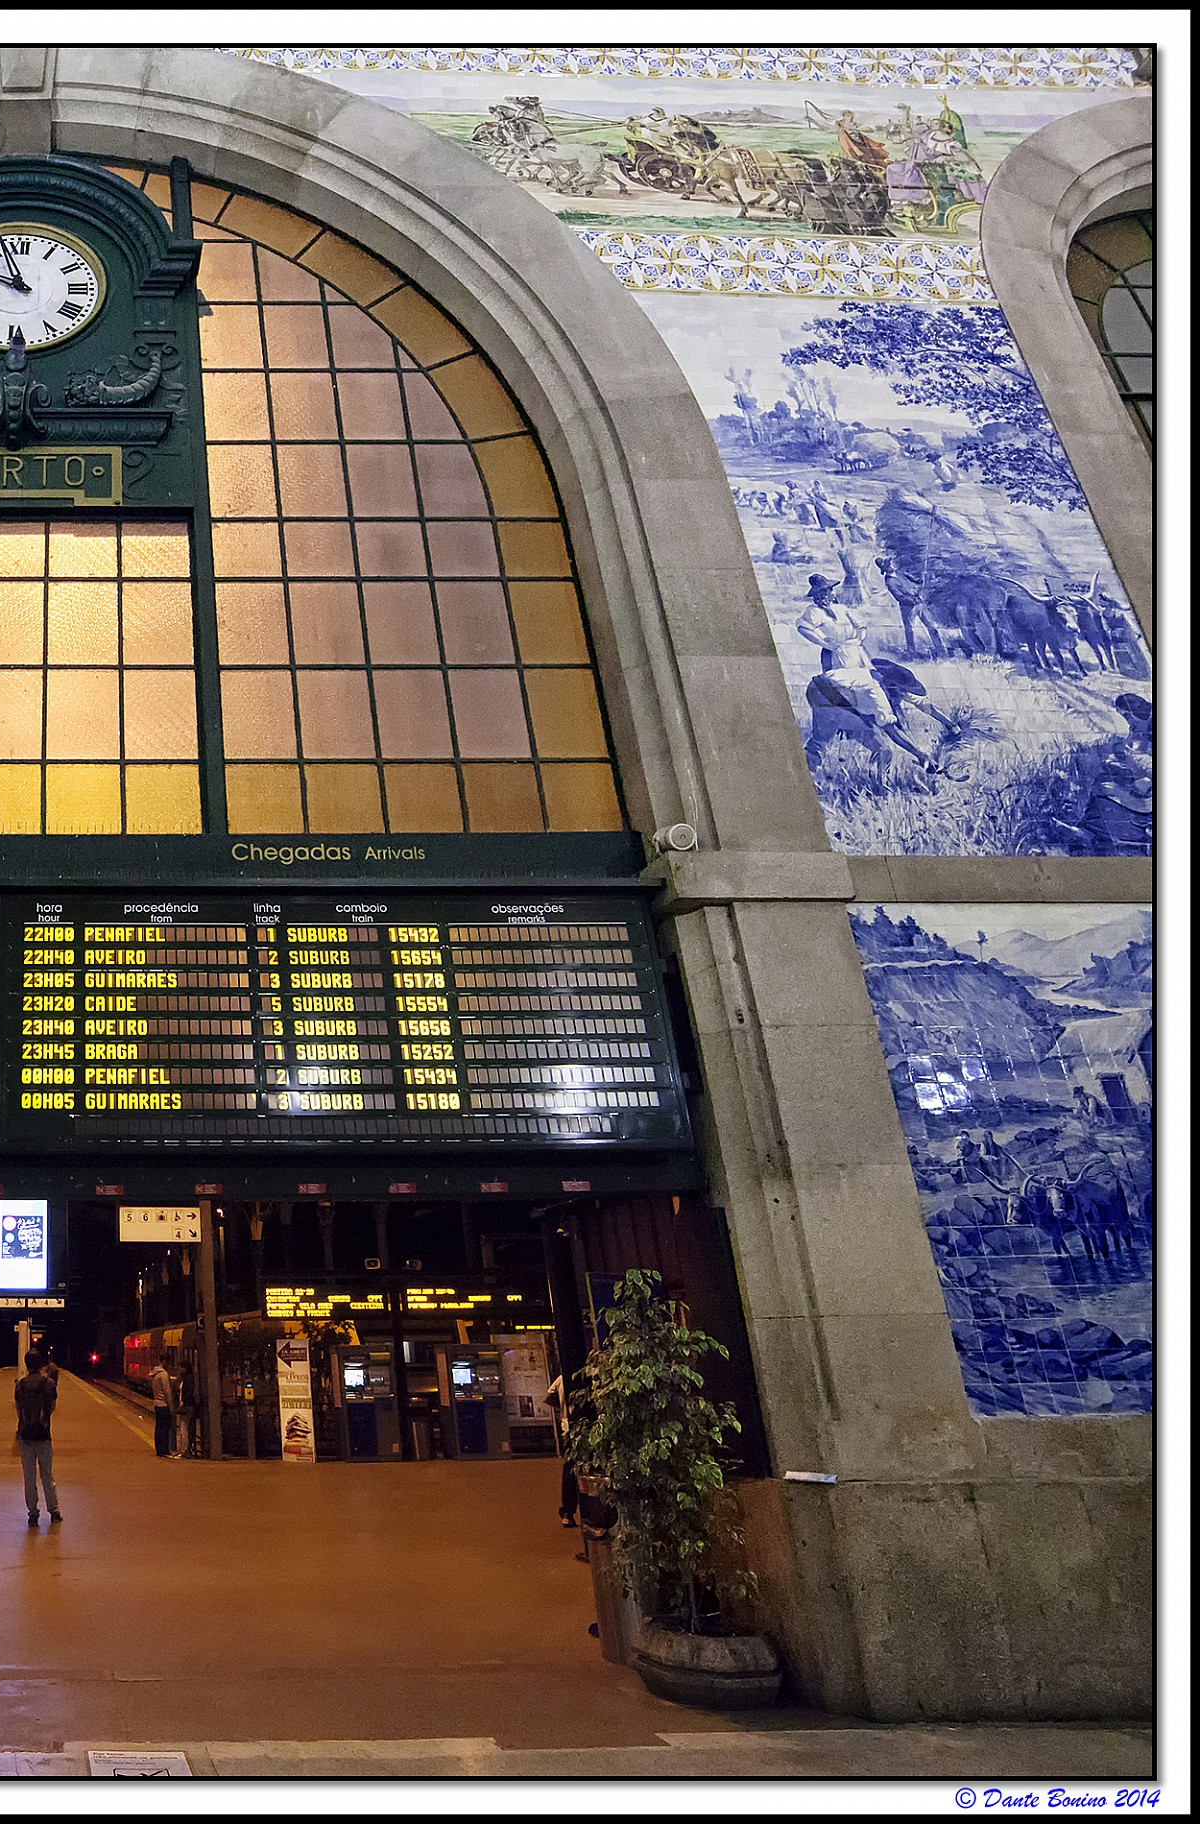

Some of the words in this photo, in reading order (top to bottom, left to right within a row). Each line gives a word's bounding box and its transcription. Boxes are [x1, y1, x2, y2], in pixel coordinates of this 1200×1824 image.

[231, 843, 351, 865] Chegadas
[364, 845, 426, 860] Arrivals
[36, 903, 63, 913] hora
[123, 903, 199, 916] procedência
[253, 902, 281, 913] linha
[335, 903, 388, 914] comboio
[491, 903, 564, 917] observações
[38, 914, 60, 922] hour
[150, 914, 173, 923] from
[255, 914, 280, 923] track
[351, 914, 374, 923] train
[507, 914, 546, 923] remarks
[23, 927, 75, 942] 22H00
[84, 927, 166, 942] PENAFIEL
[267, 928, 276, 942] 1
[287, 928, 348, 942] SUBURB
[388, 928, 440, 942] 15432
[23, 950, 75, 964] 22H40
[84, 950, 146, 965] AVEIRO
[268, 950, 279, 965] 2
[289, 950, 350, 965] SUBURB
[390, 950, 442, 965] 15654
[23, 973, 75, 988] 23H05
[84, 973, 177, 988] GUIMARAES
[270, 973, 280, 988] 3
[291, 973, 352, 988] SUBURB
[393, 973, 445, 988] 15178
[22, 996, 75, 1011] 23H20
[85, 996, 137, 1011] CAIDE
[271, 996, 282, 1011] 5
[292, 996, 354, 1011] SUBURB
[395, 996, 448, 1011] 15554
[22, 1020, 75, 1035] 23H40
[84, 1020, 148, 1035] AVEIRO
[273, 1020, 284, 1035] 3
[294, 1020, 357, 1035] SUBURB
[398, 1020, 451, 1036] 15656
[21, 1043, 75, 1059] 23H45
[85, 1044, 138, 1059] BRAGA
[275, 1044, 284, 1060] 1
[296, 1044, 359, 1060] SUBURB
[401, 1044, 454, 1060] 15252
[21, 1068, 75, 1084] 00H00
[85, 1068, 170, 1084] PENAFIEL
[276, 1068, 287, 1084] 2
[298, 1068, 361, 1084] SUBURB
[403, 1068, 458, 1084] 15434
[21, 1093, 75, 1109] 00H05
[85, 1093, 182, 1109] GUIMARAES
[278, 1093, 289, 1109] 3
[300, 1093, 364, 1109] SUBURB
[406, 1093, 460, 1110] 15180
[126, 1213, 132, 1222] 5
[142, 1213, 149, 1222] 6
[175, 1230, 181, 1239] 4
